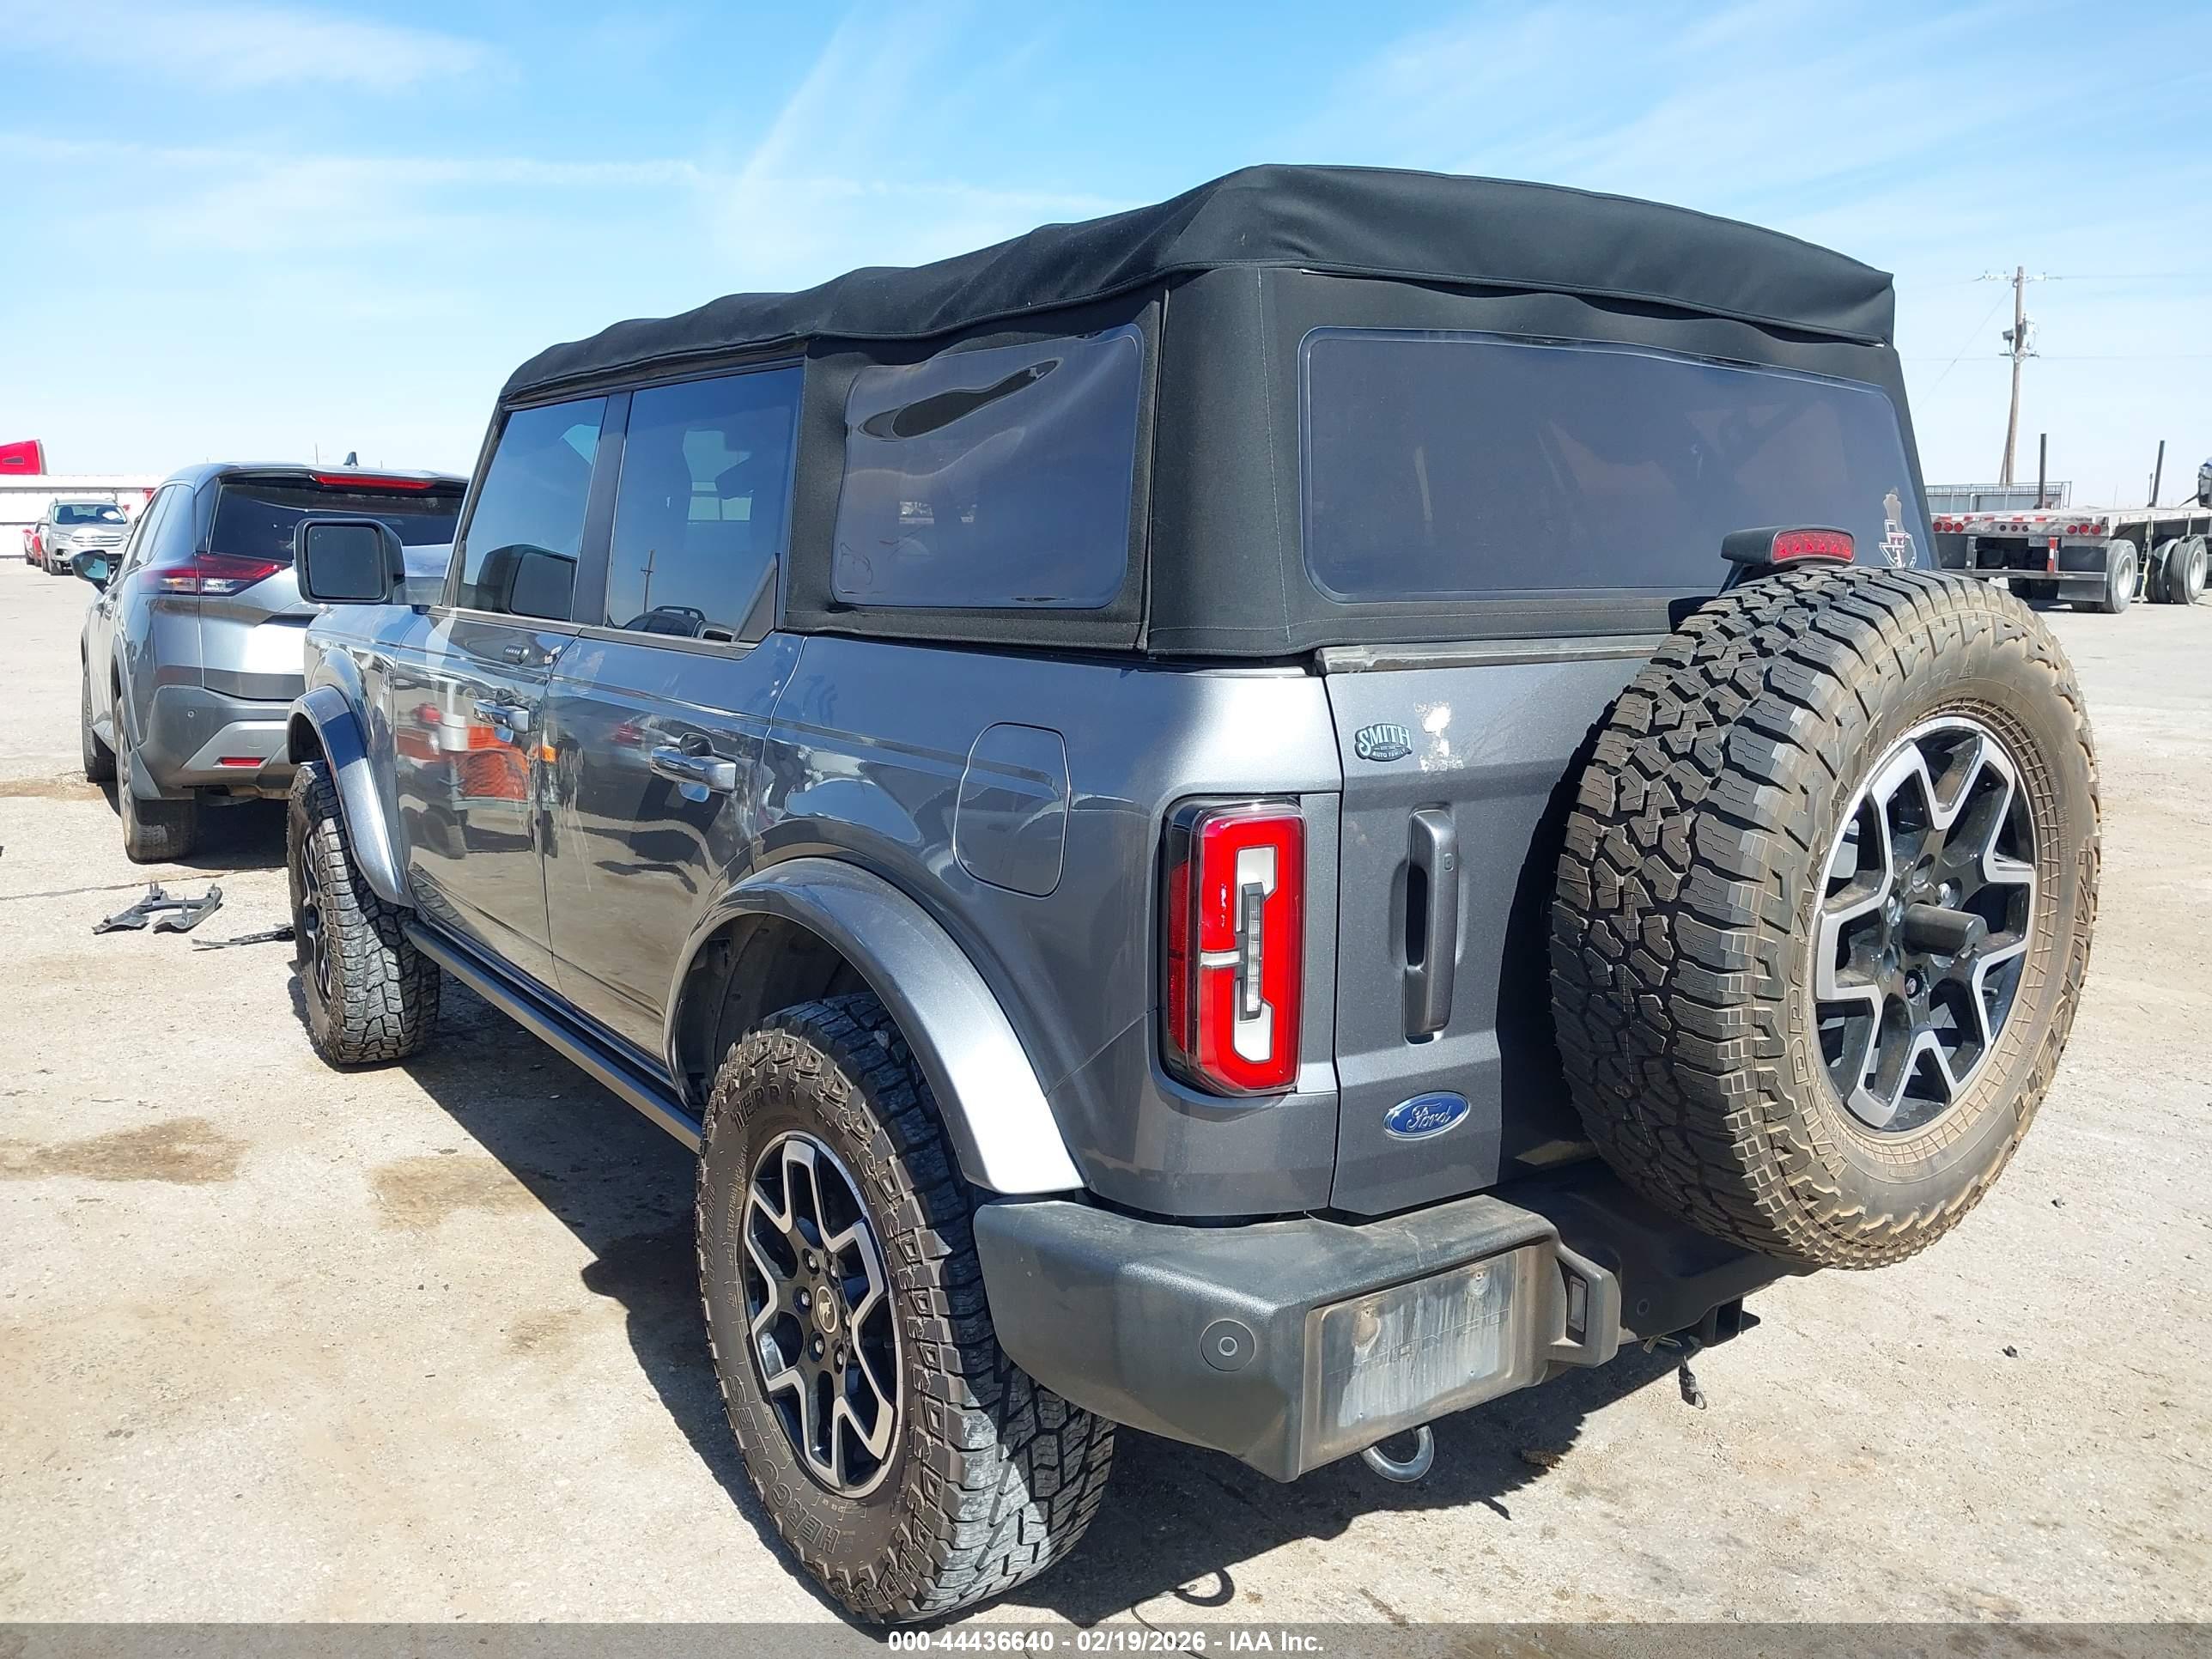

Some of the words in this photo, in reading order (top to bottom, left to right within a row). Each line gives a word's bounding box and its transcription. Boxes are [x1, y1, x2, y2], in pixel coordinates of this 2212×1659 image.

[1358, 725, 1413, 757] SMITH
[1406, 1102, 1452, 1132] Ford
[726, 1375, 841, 1554] HERCULES
